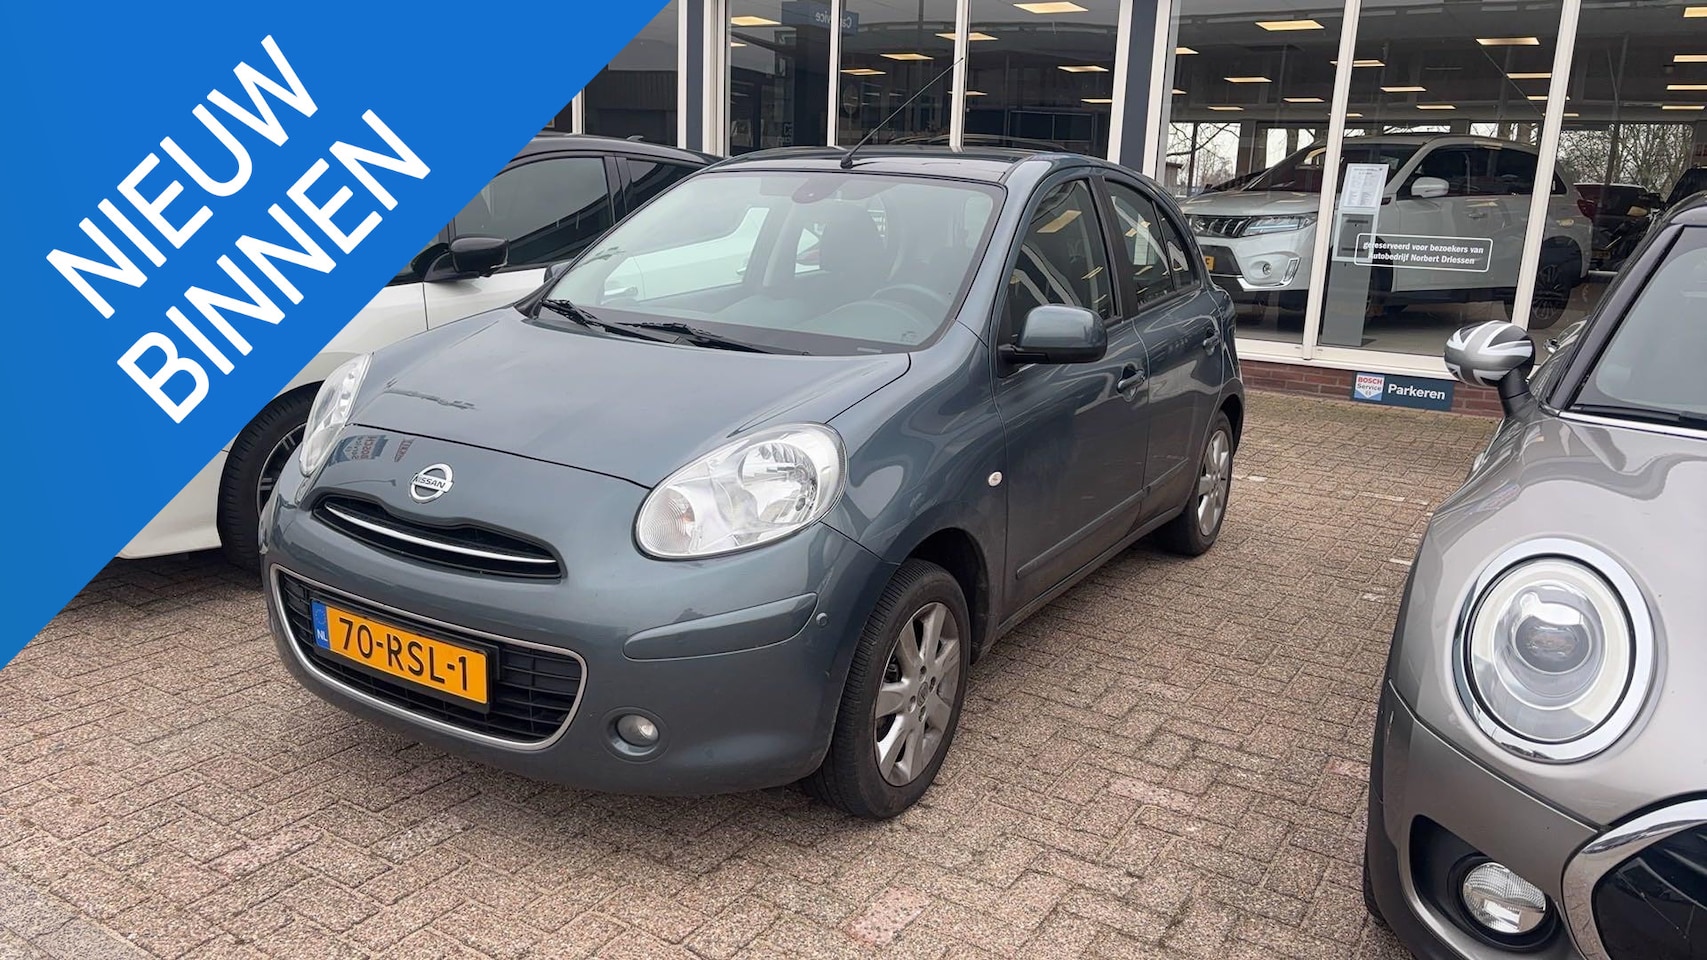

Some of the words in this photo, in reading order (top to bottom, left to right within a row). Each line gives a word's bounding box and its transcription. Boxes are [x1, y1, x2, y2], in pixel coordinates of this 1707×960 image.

[1363, 241, 1410, 251] gereserveerd
[1412, 243, 1428, 251] voor
[1430, 244, 1468, 253] bezoekers
[1470, 246, 1484, 254] van
[1368, 252, 1408, 262] Autobedrijf
[1411, 254, 1438, 263] Norbert
[1441, 256, 1475, 265] Driessen
[1357, 383, 1381, 391] Service
[1358, 376, 1382, 385] BOSCH
[1388, 383, 1446, 400] Parkeren
[413, 475, 446, 488] NISSAN
[316, 629, 328, 642] NL
[339, 617, 468, 691] 70-RSL-1
